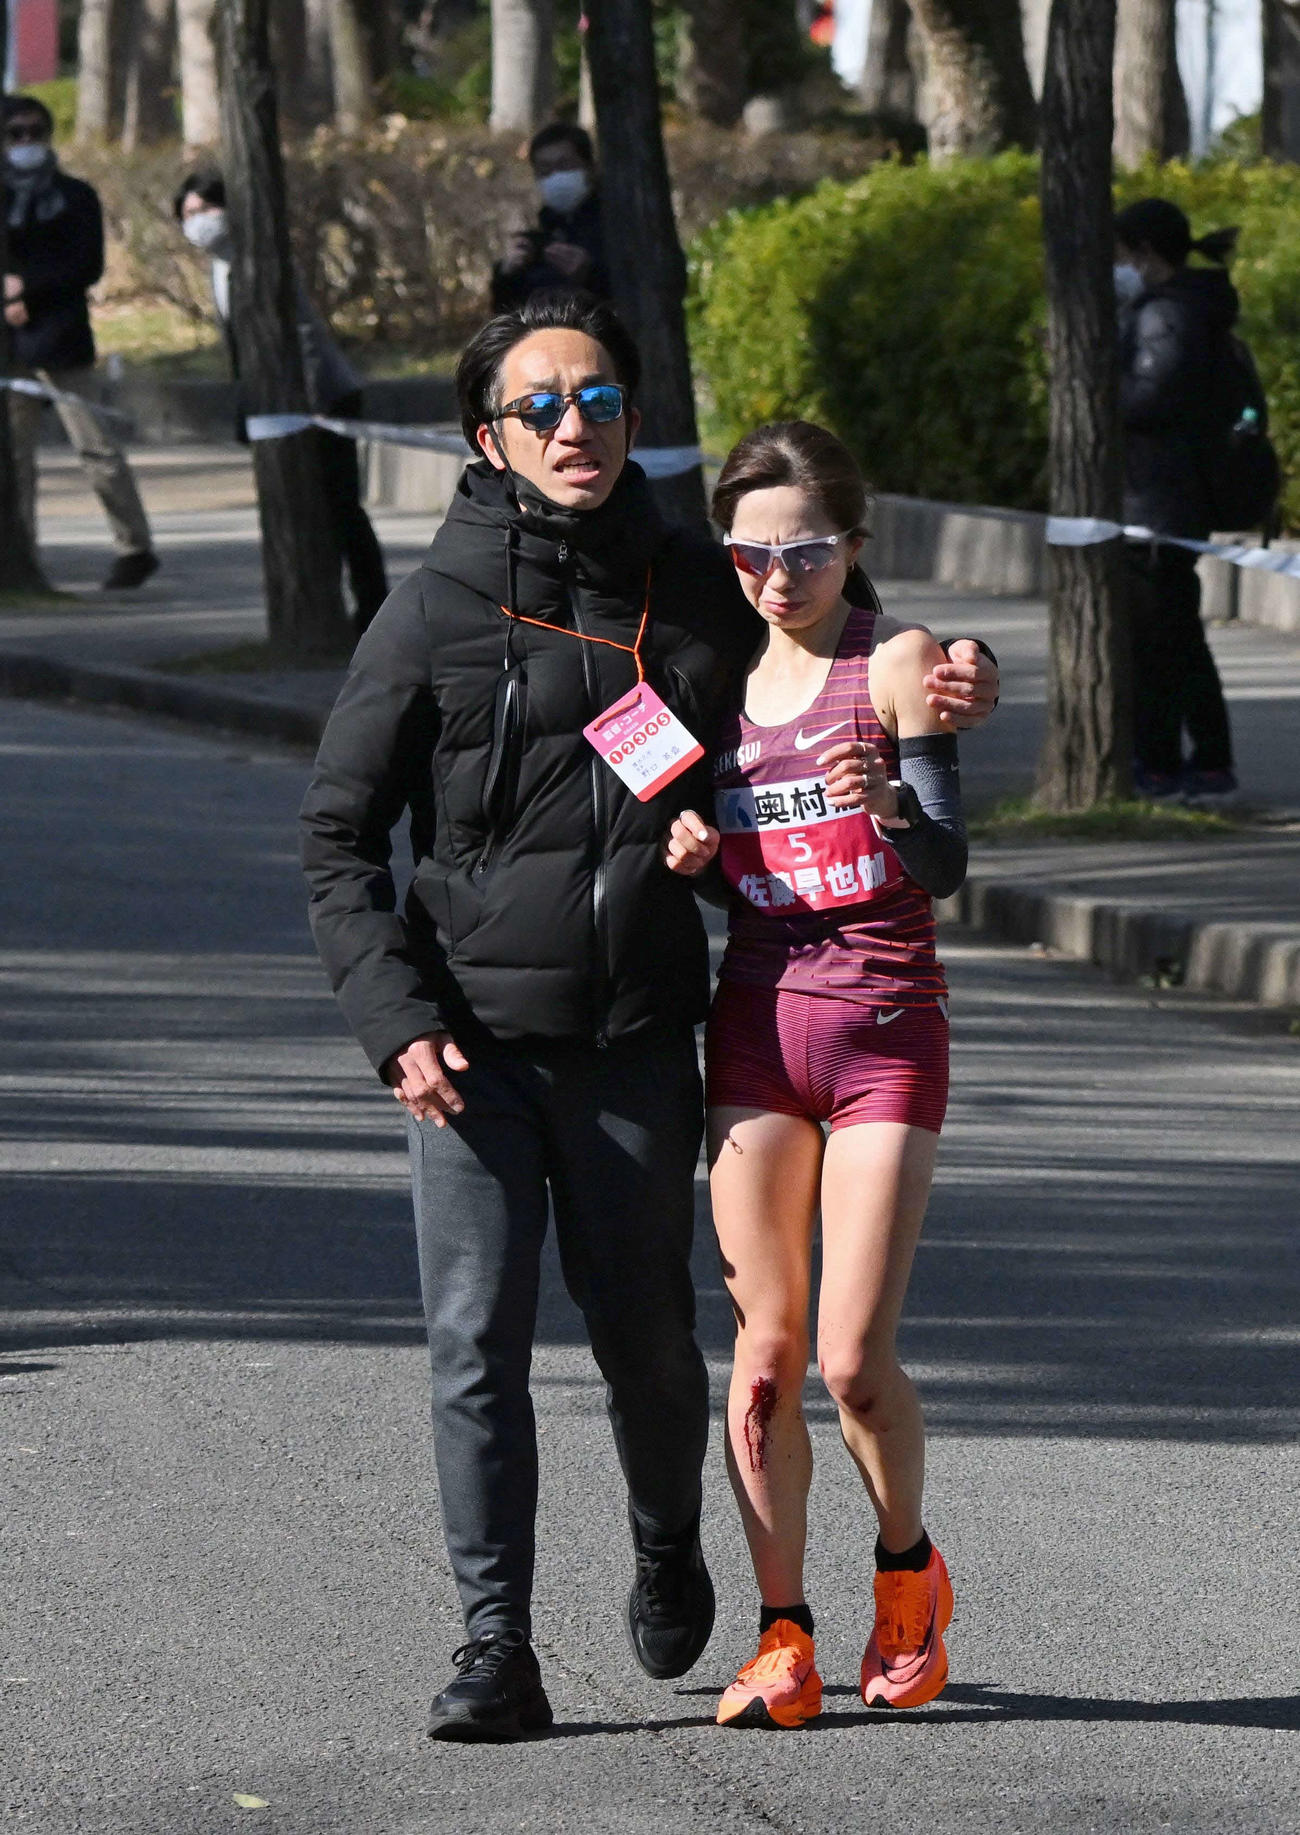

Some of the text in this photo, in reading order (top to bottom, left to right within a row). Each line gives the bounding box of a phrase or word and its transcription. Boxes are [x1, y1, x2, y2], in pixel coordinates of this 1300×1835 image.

[713, 740, 761, 777] SEKISUI
[755, 782, 862, 826] 奥村
[787, 832, 813, 863] 5
[738, 851, 888, 908] 佐藤早也伽
